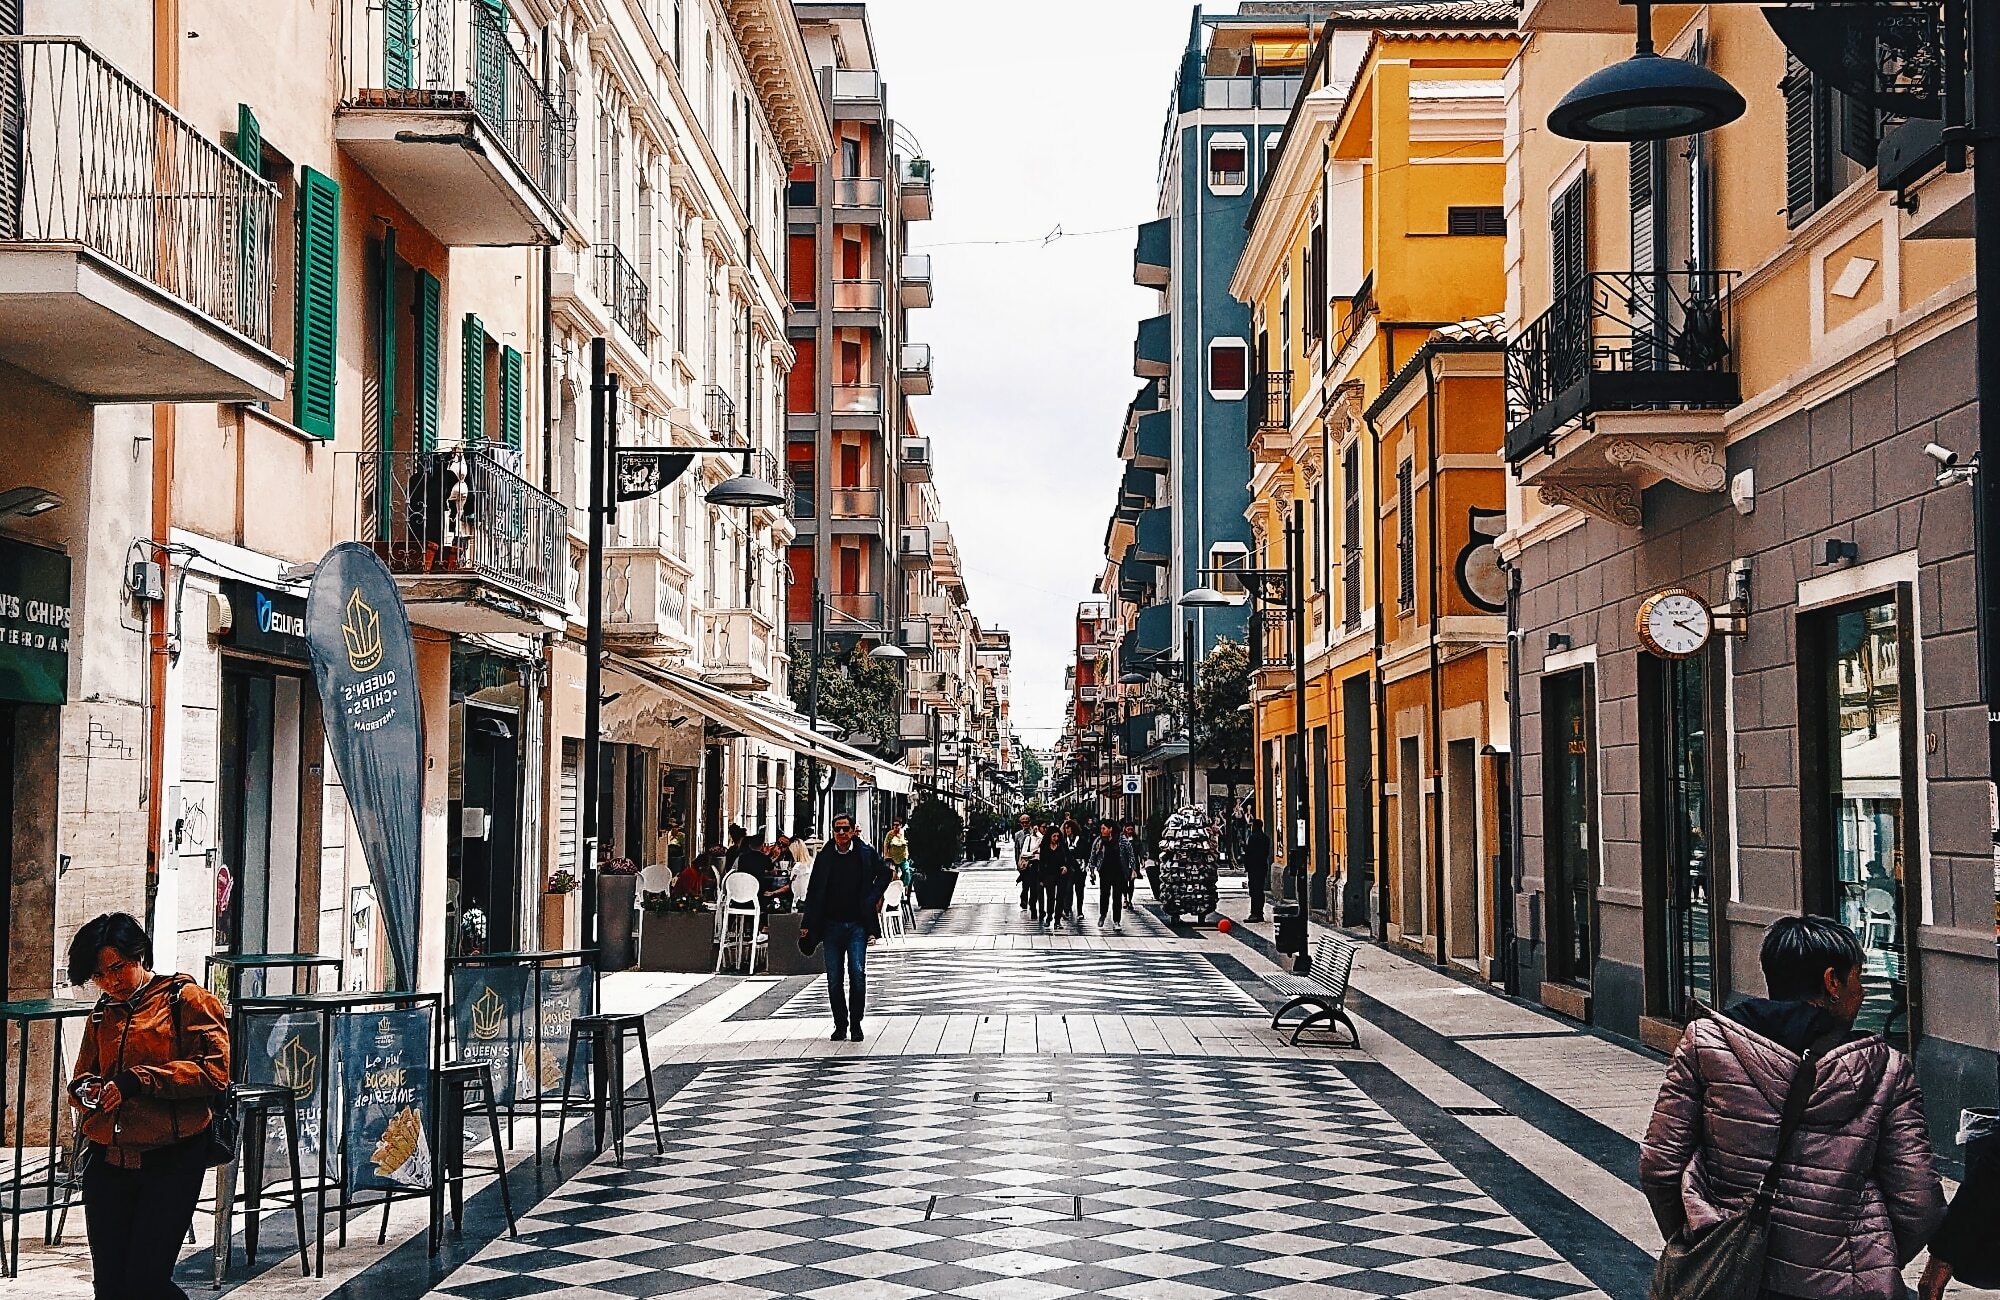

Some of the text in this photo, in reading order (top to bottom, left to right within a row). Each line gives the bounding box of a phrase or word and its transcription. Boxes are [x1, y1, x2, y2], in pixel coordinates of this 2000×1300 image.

[26, 600, 71, 629] CHIPS
[463, 1045, 510, 1058] QUEEN'S
[364, 1068, 408, 1089] BUONE
